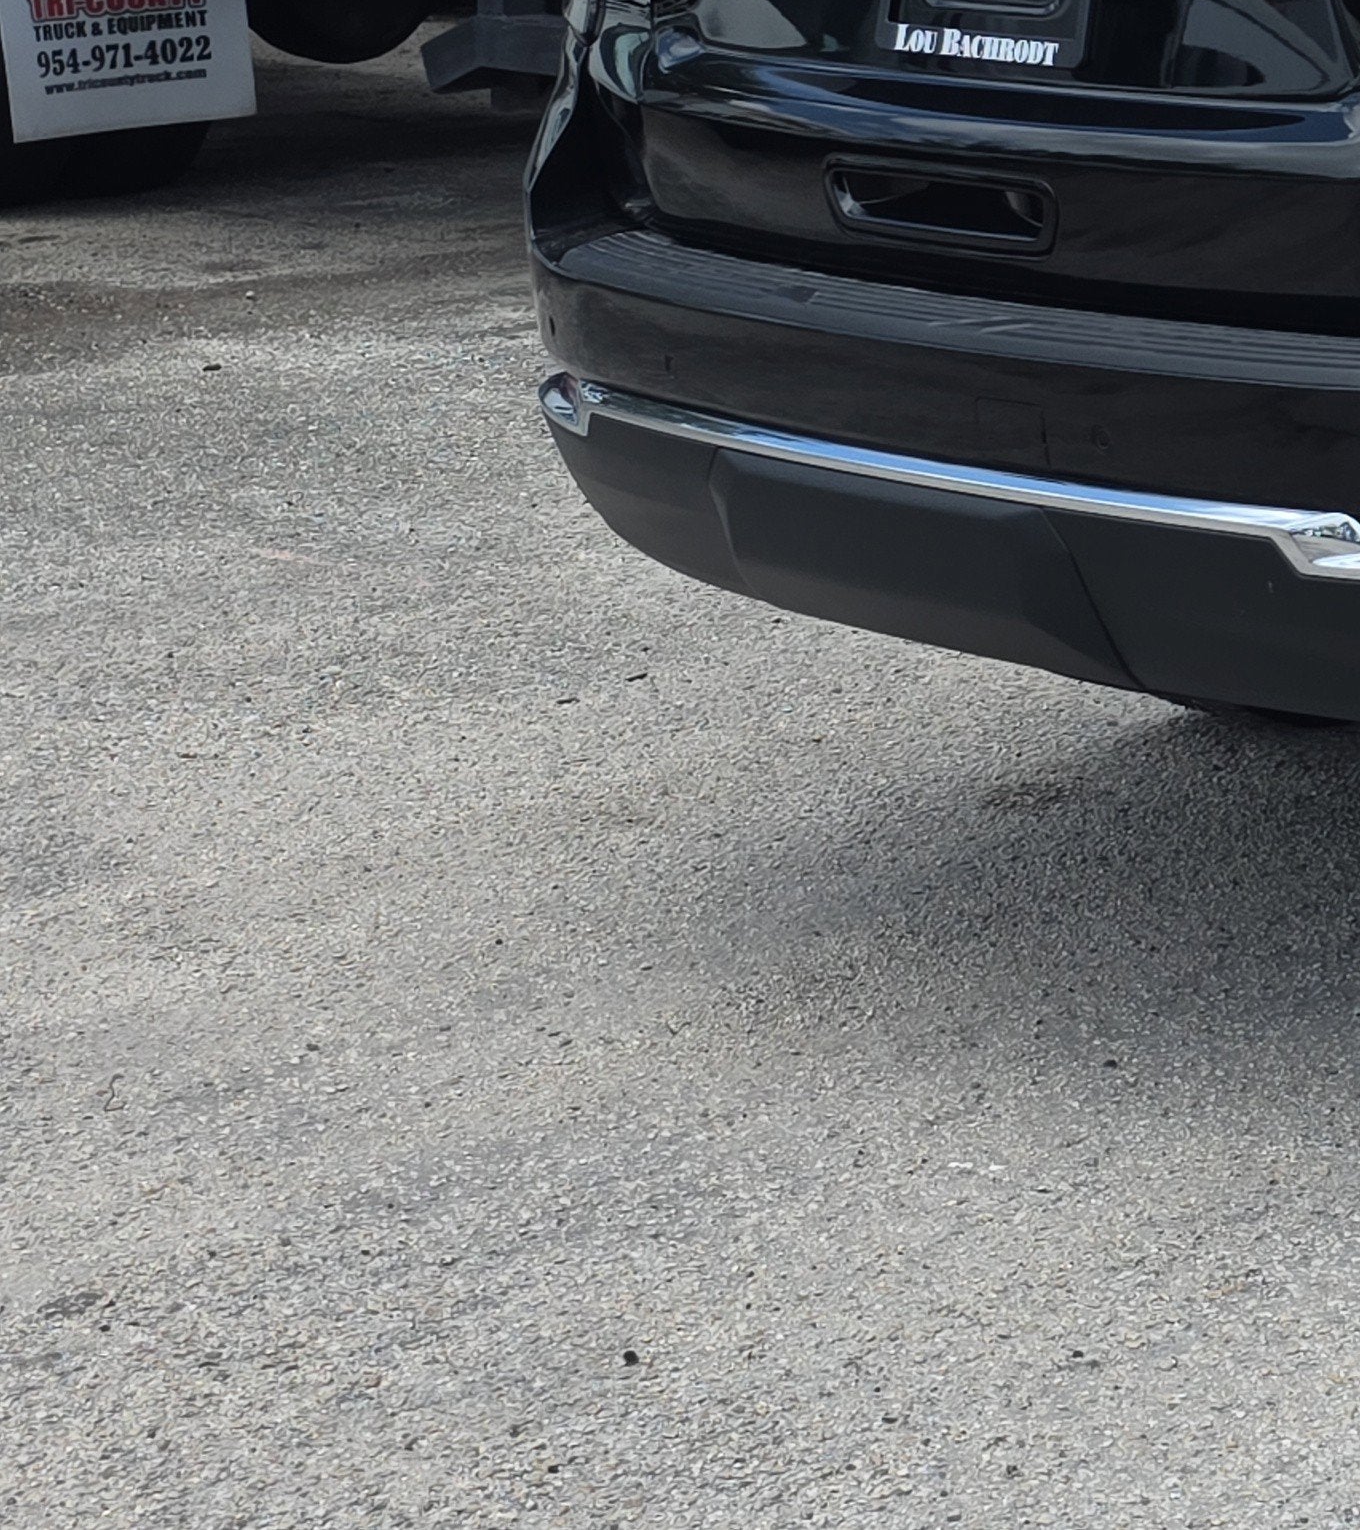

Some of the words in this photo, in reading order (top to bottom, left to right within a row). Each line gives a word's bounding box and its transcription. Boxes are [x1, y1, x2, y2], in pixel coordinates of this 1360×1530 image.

[33, 20, 87, 42] TRUCK
[91, 21, 103, 36] &
[107, 10, 208, 36] EQUIPMENT
[37, 35, 213, 79] 954-971-4022
